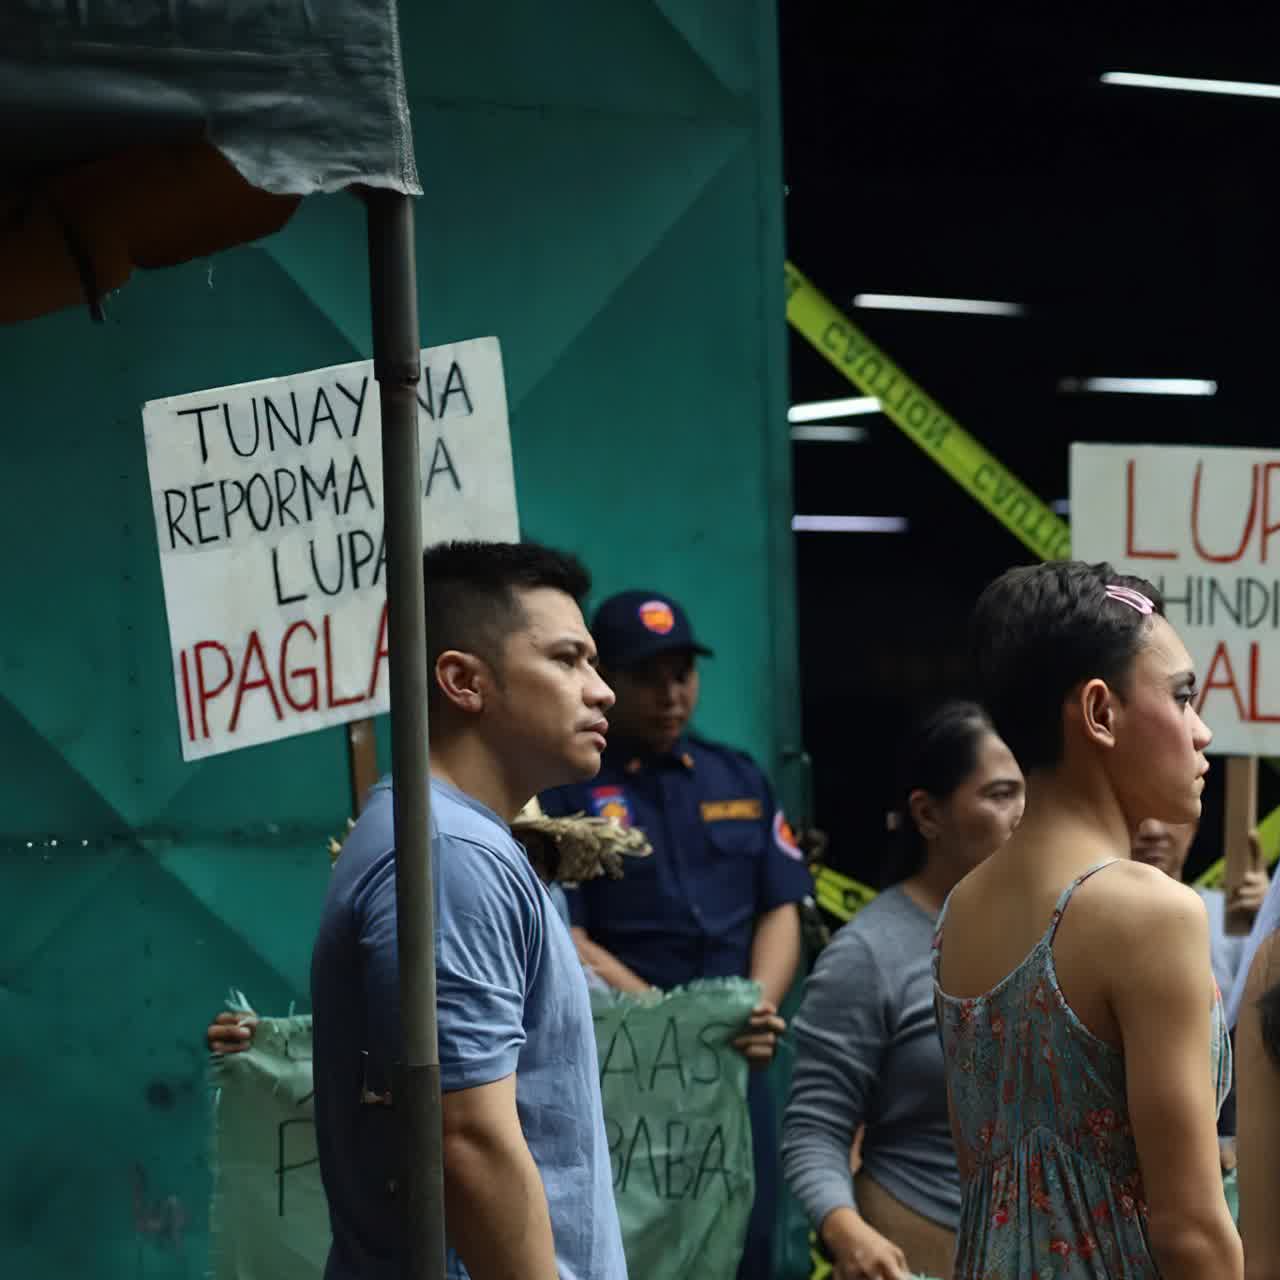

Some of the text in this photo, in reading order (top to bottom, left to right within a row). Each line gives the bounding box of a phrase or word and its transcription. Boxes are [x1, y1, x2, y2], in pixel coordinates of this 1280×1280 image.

[177, 376, 369, 464] TUNAY
[164, 455, 375, 549] REPORMA
[1160, 576, 1280, 629] HINDI
